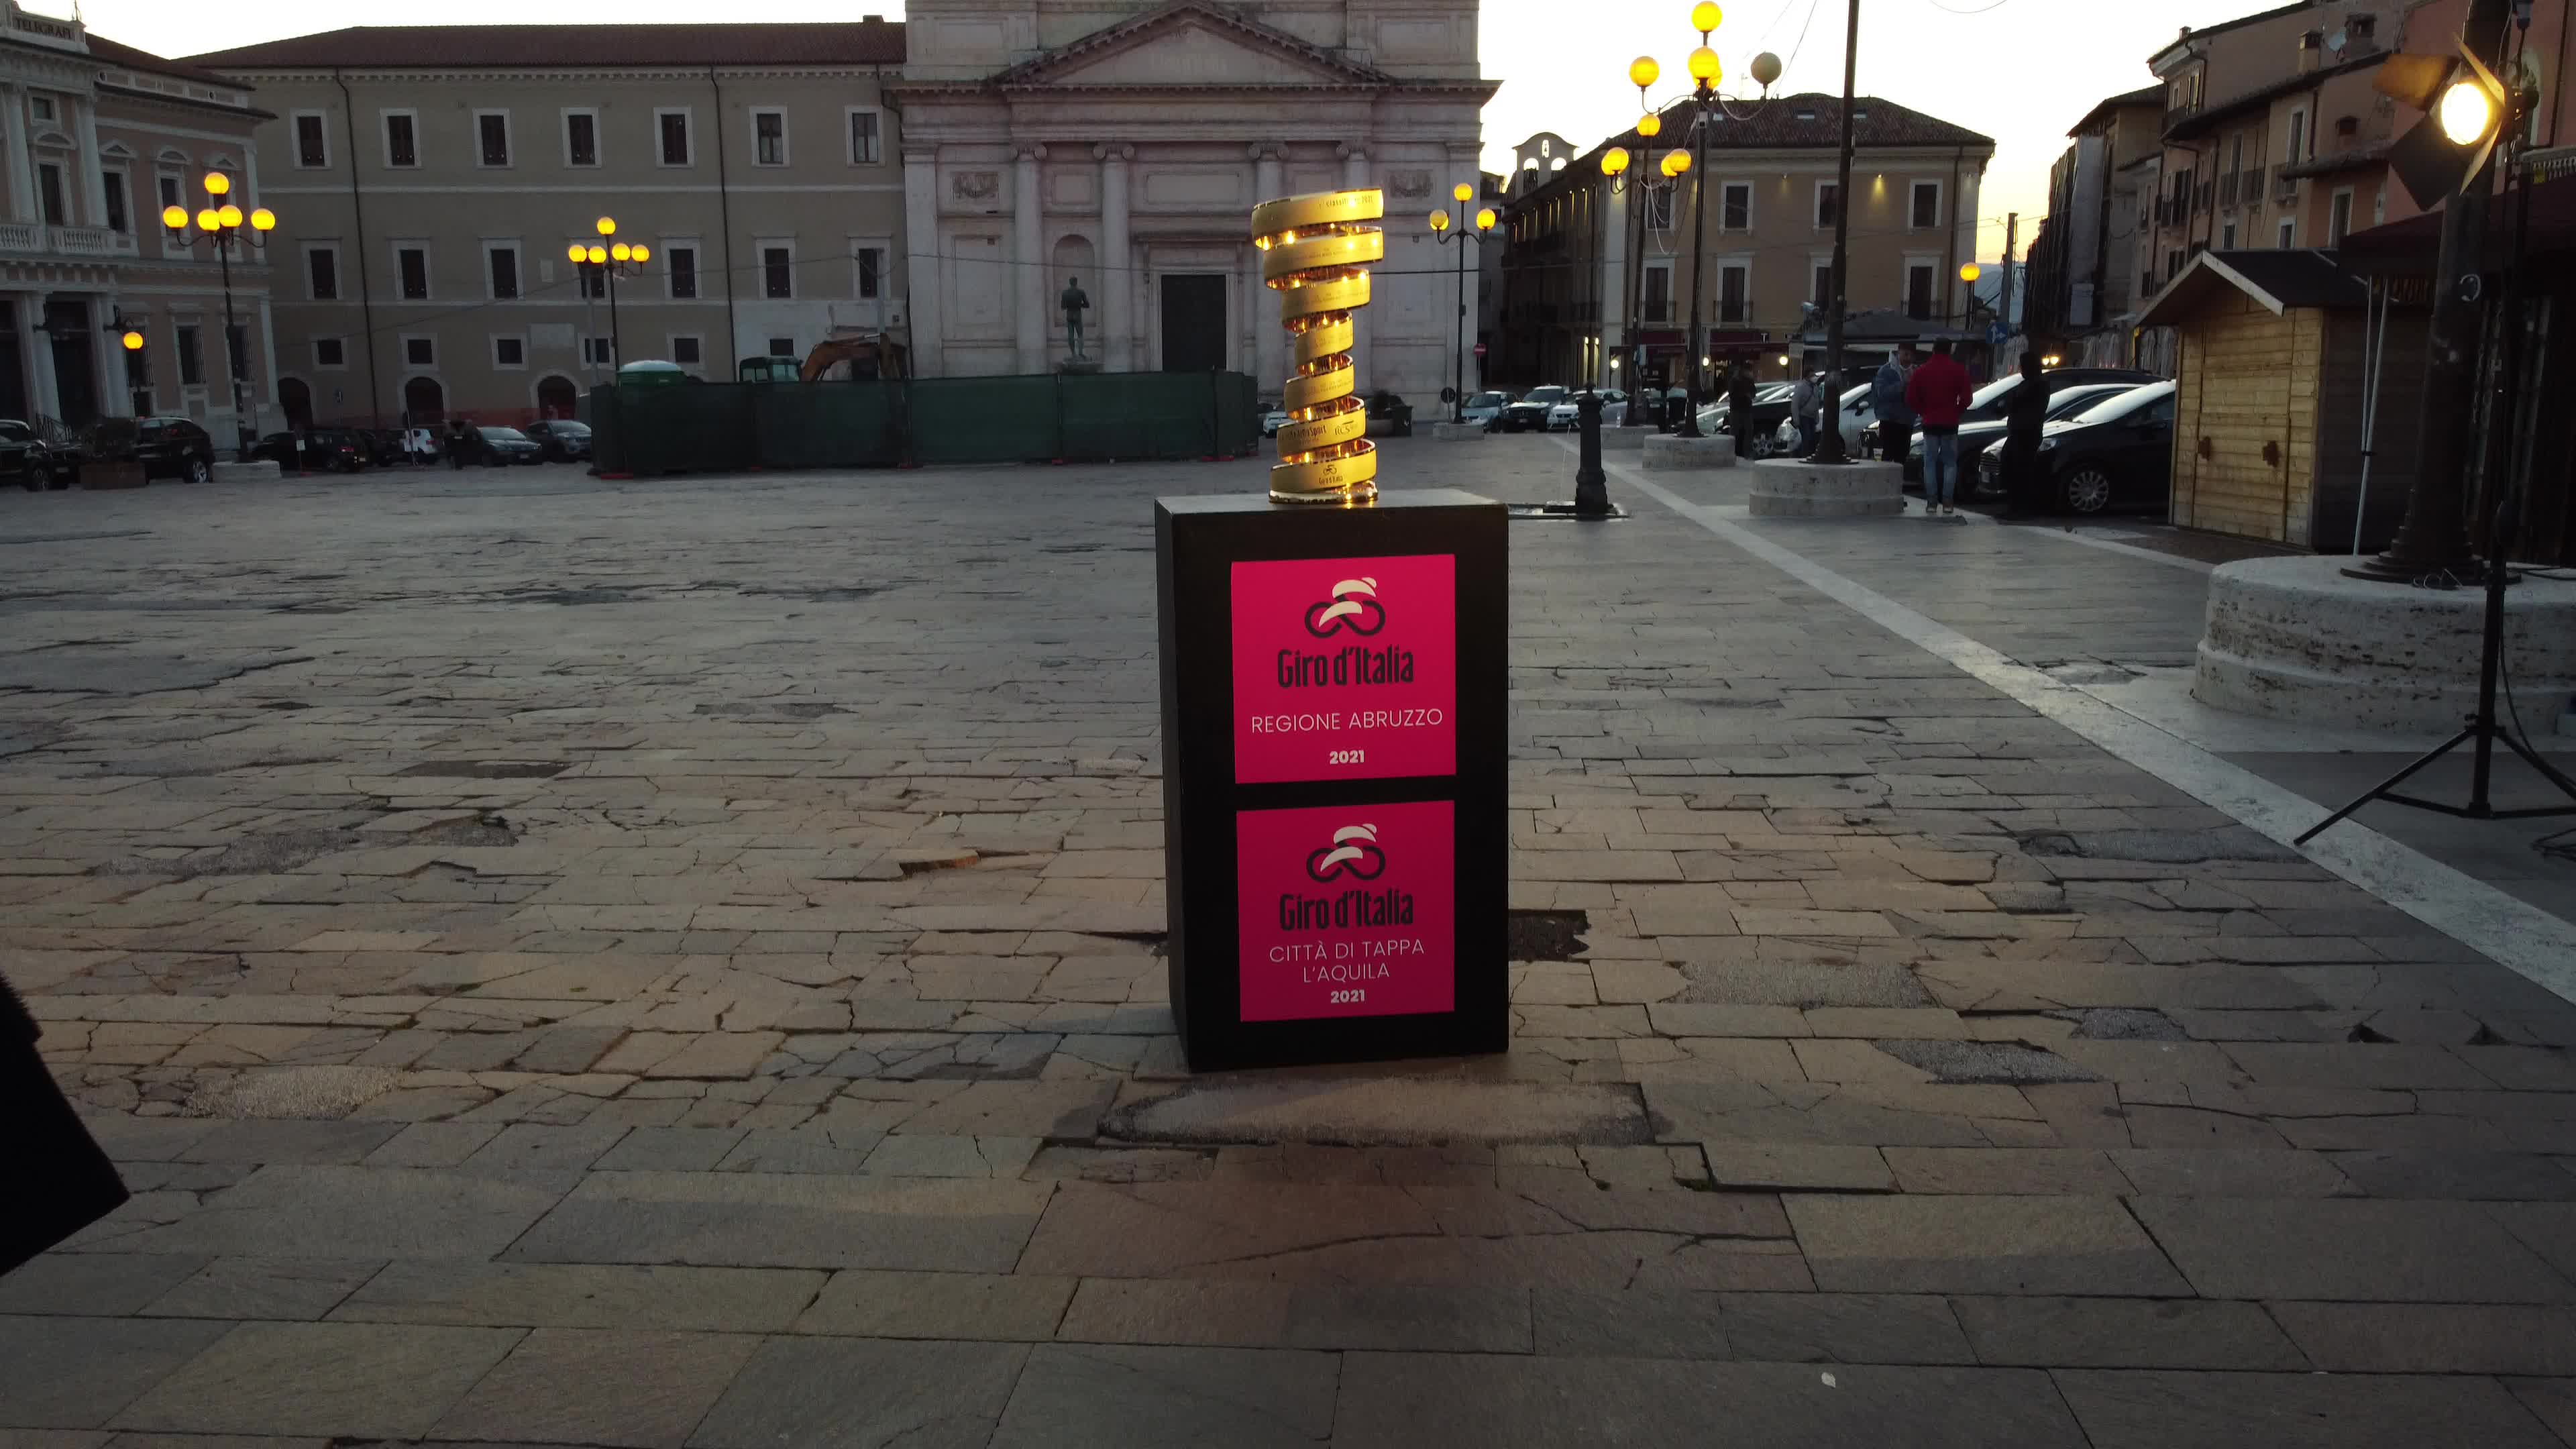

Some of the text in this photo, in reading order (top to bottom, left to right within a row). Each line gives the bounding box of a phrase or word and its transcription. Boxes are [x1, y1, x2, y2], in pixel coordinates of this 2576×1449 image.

[1278, 645, 1413, 688] Giro d'Italia
[1252, 708, 1443, 733] REGIONE ABRUZZO
[1330, 750, 1364, 764] 2021
[1279, 888, 1413, 931] Giro d'Italia
[1269, 938, 1424, 962] CITTÀ DI TAPPA
[1303, 963, 1390, 983] L'AQUILA
[1330, 989, 1365, 1004] 2021
